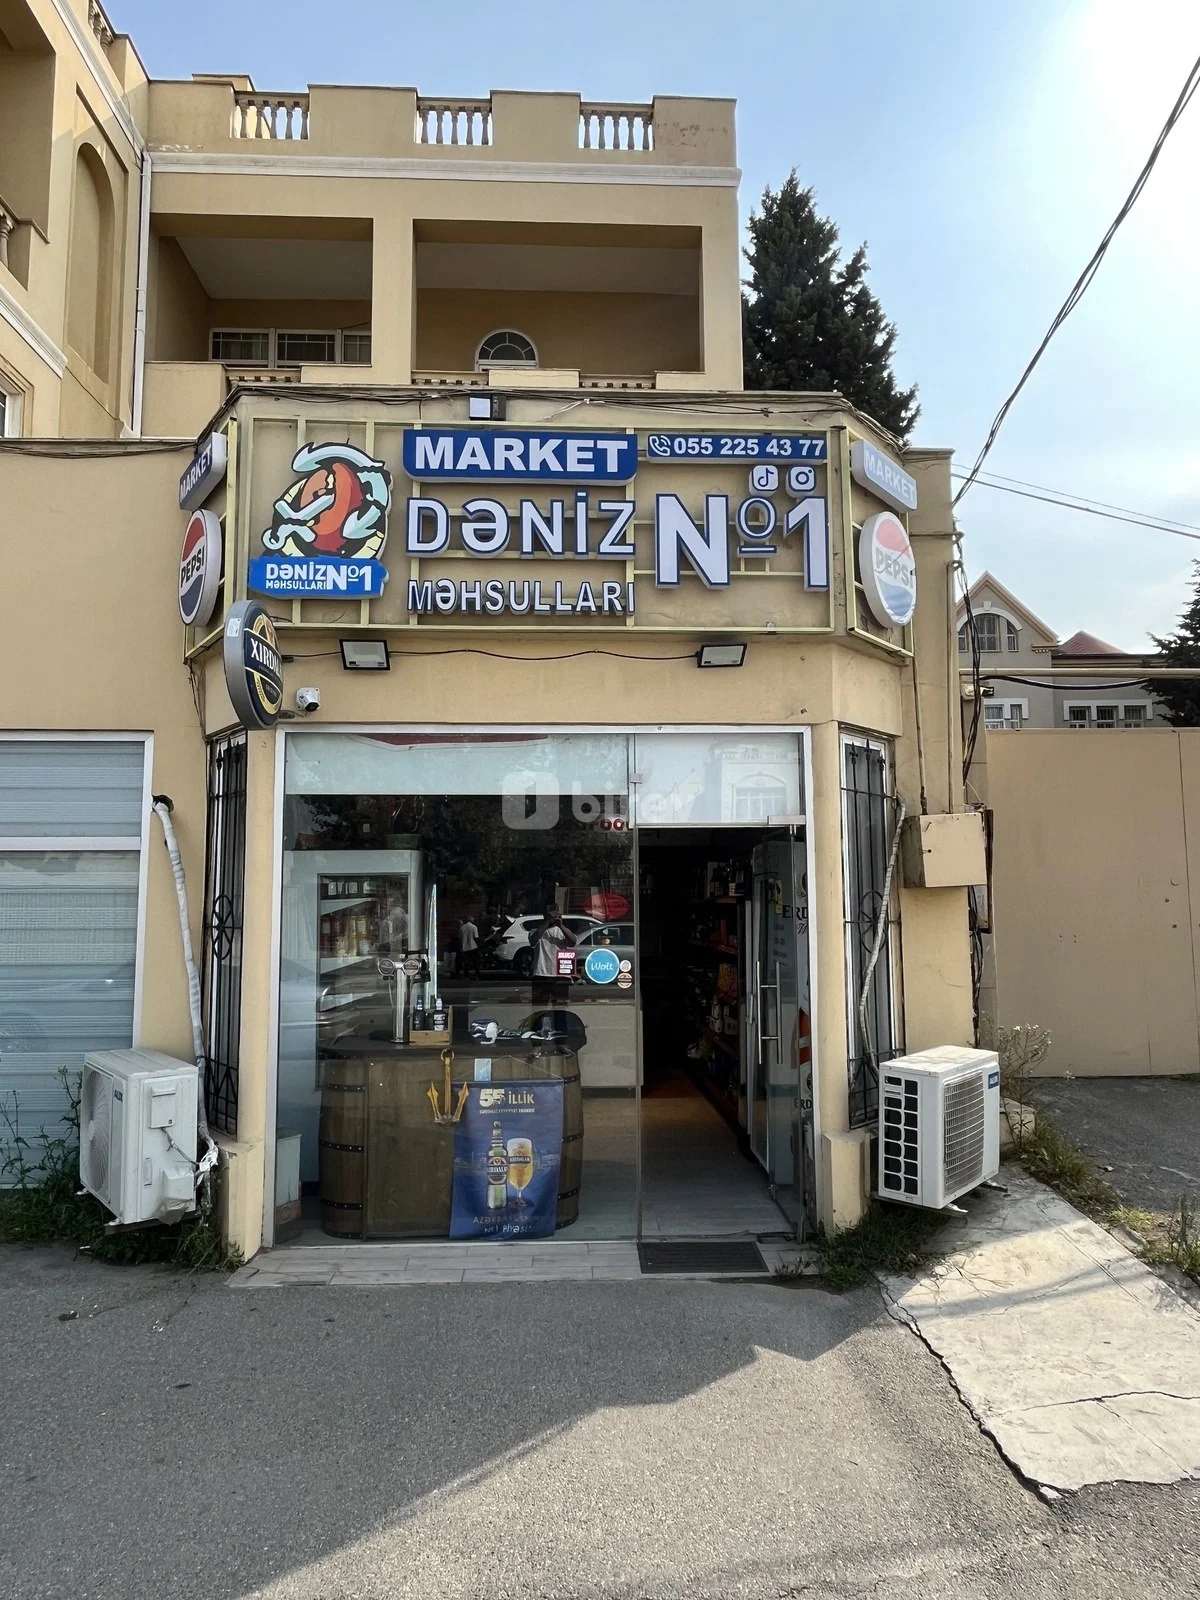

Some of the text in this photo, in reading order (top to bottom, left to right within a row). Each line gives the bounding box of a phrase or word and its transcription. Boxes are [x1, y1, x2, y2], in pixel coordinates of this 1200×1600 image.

[414, 436, 629, 473] MARKET
[674, 437, 825, 456] 055 225 43 77
[180, 447, 213, 500] MARKET
[864, 450, 916, 500] MARKET
[407, 491, 636, 554] DƏNİZ
[180, 545, 205, 587] PEPSI
[266, 561, 326, 580] DƏNİZ
[875, 546, 914, 588] PEPSI
[265, 580, 327, 590] MƏHSULLARI
[407, 579, 636, 612] MƏHSULLARI
[590, 962, 614, 971] Wolt
[479, 1088, 534, 1107] 55 İLLİK
